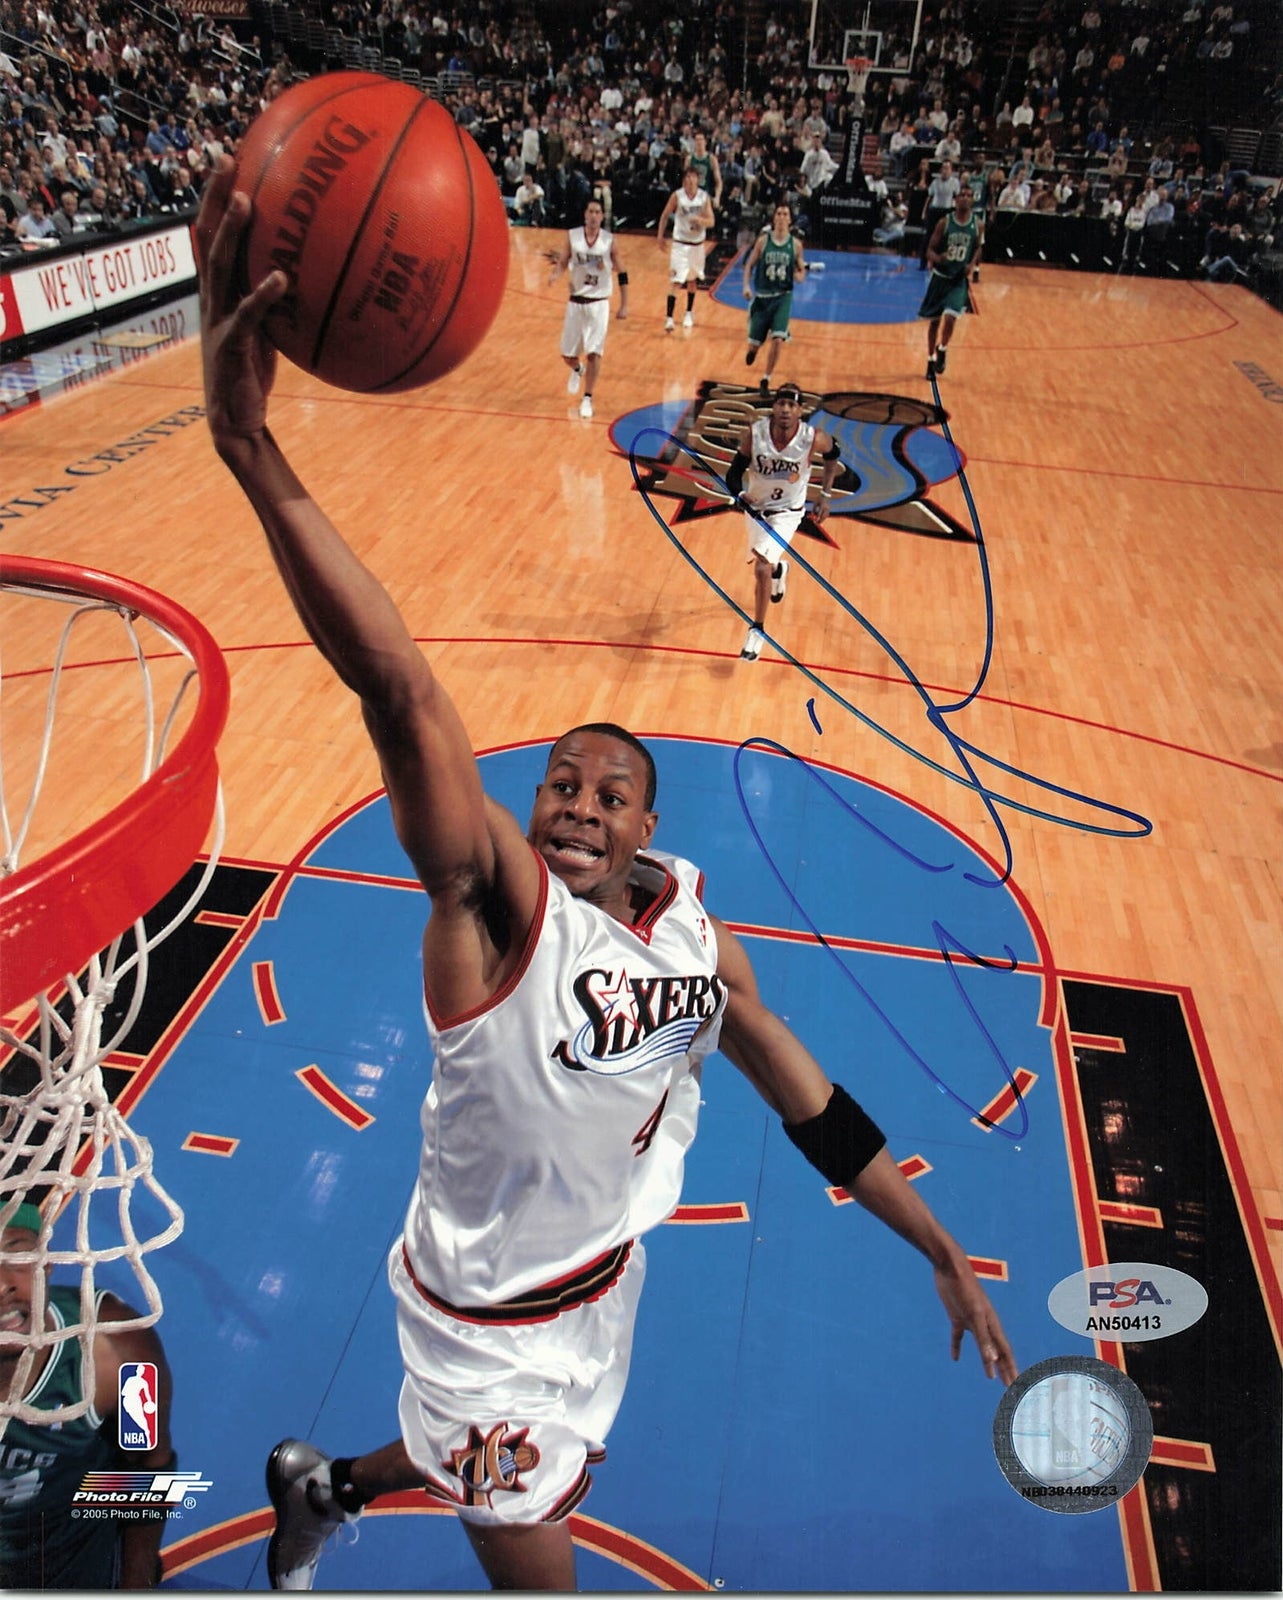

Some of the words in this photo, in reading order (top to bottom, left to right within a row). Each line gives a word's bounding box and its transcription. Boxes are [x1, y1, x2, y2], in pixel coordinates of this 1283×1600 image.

[946, 245, 967, 262] 30
[38, 258, 101, 311] WE'VE
[103, 248, 136, 293] GOT
[139, 236, 177, 282] JOBS
[766, 264, 787, 281] 44
[0, 484, 79, 530] VIA
[65, 405, 207, 476] CENTER
[756, 455, 801, 476] SIXERS
[771, 488, 784, 501] 3
[551, 968, 728, 1071] SIXERS
[631, 1087, 669, 1157] 4
[1086, 1316, 1162, 1331] AN50413
[1055, 1450, 1079, 1463] NBA
